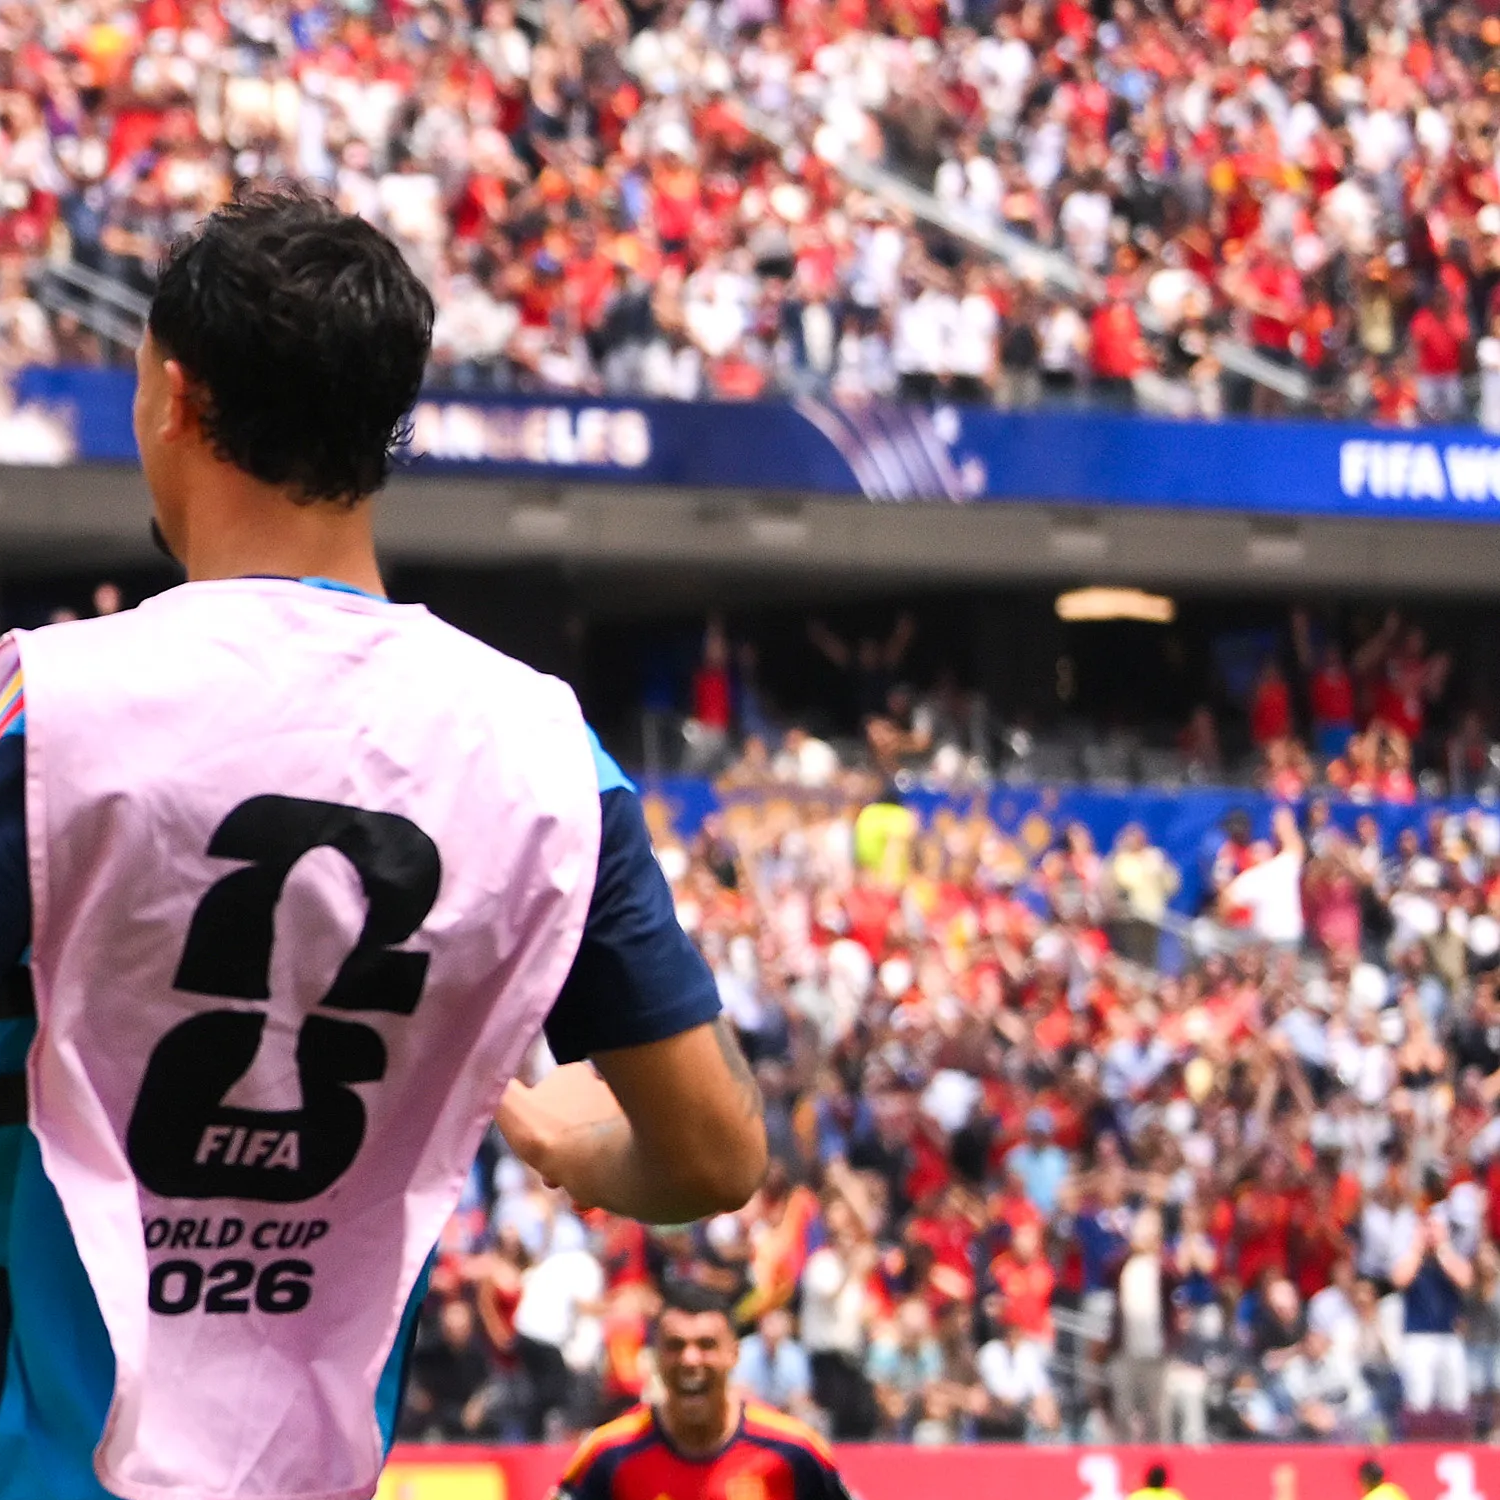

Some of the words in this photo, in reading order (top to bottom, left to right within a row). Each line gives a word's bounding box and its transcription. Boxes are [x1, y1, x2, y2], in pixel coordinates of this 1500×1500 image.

[1340, 440, 1447, 500] FIFA
[194, 1123, 301, 1171] FIFA
[143, 1216, 246, 1250] ORLD
[251, 1219, 331, 1251] CUP
[147, 1258, 317, 1316] 026
